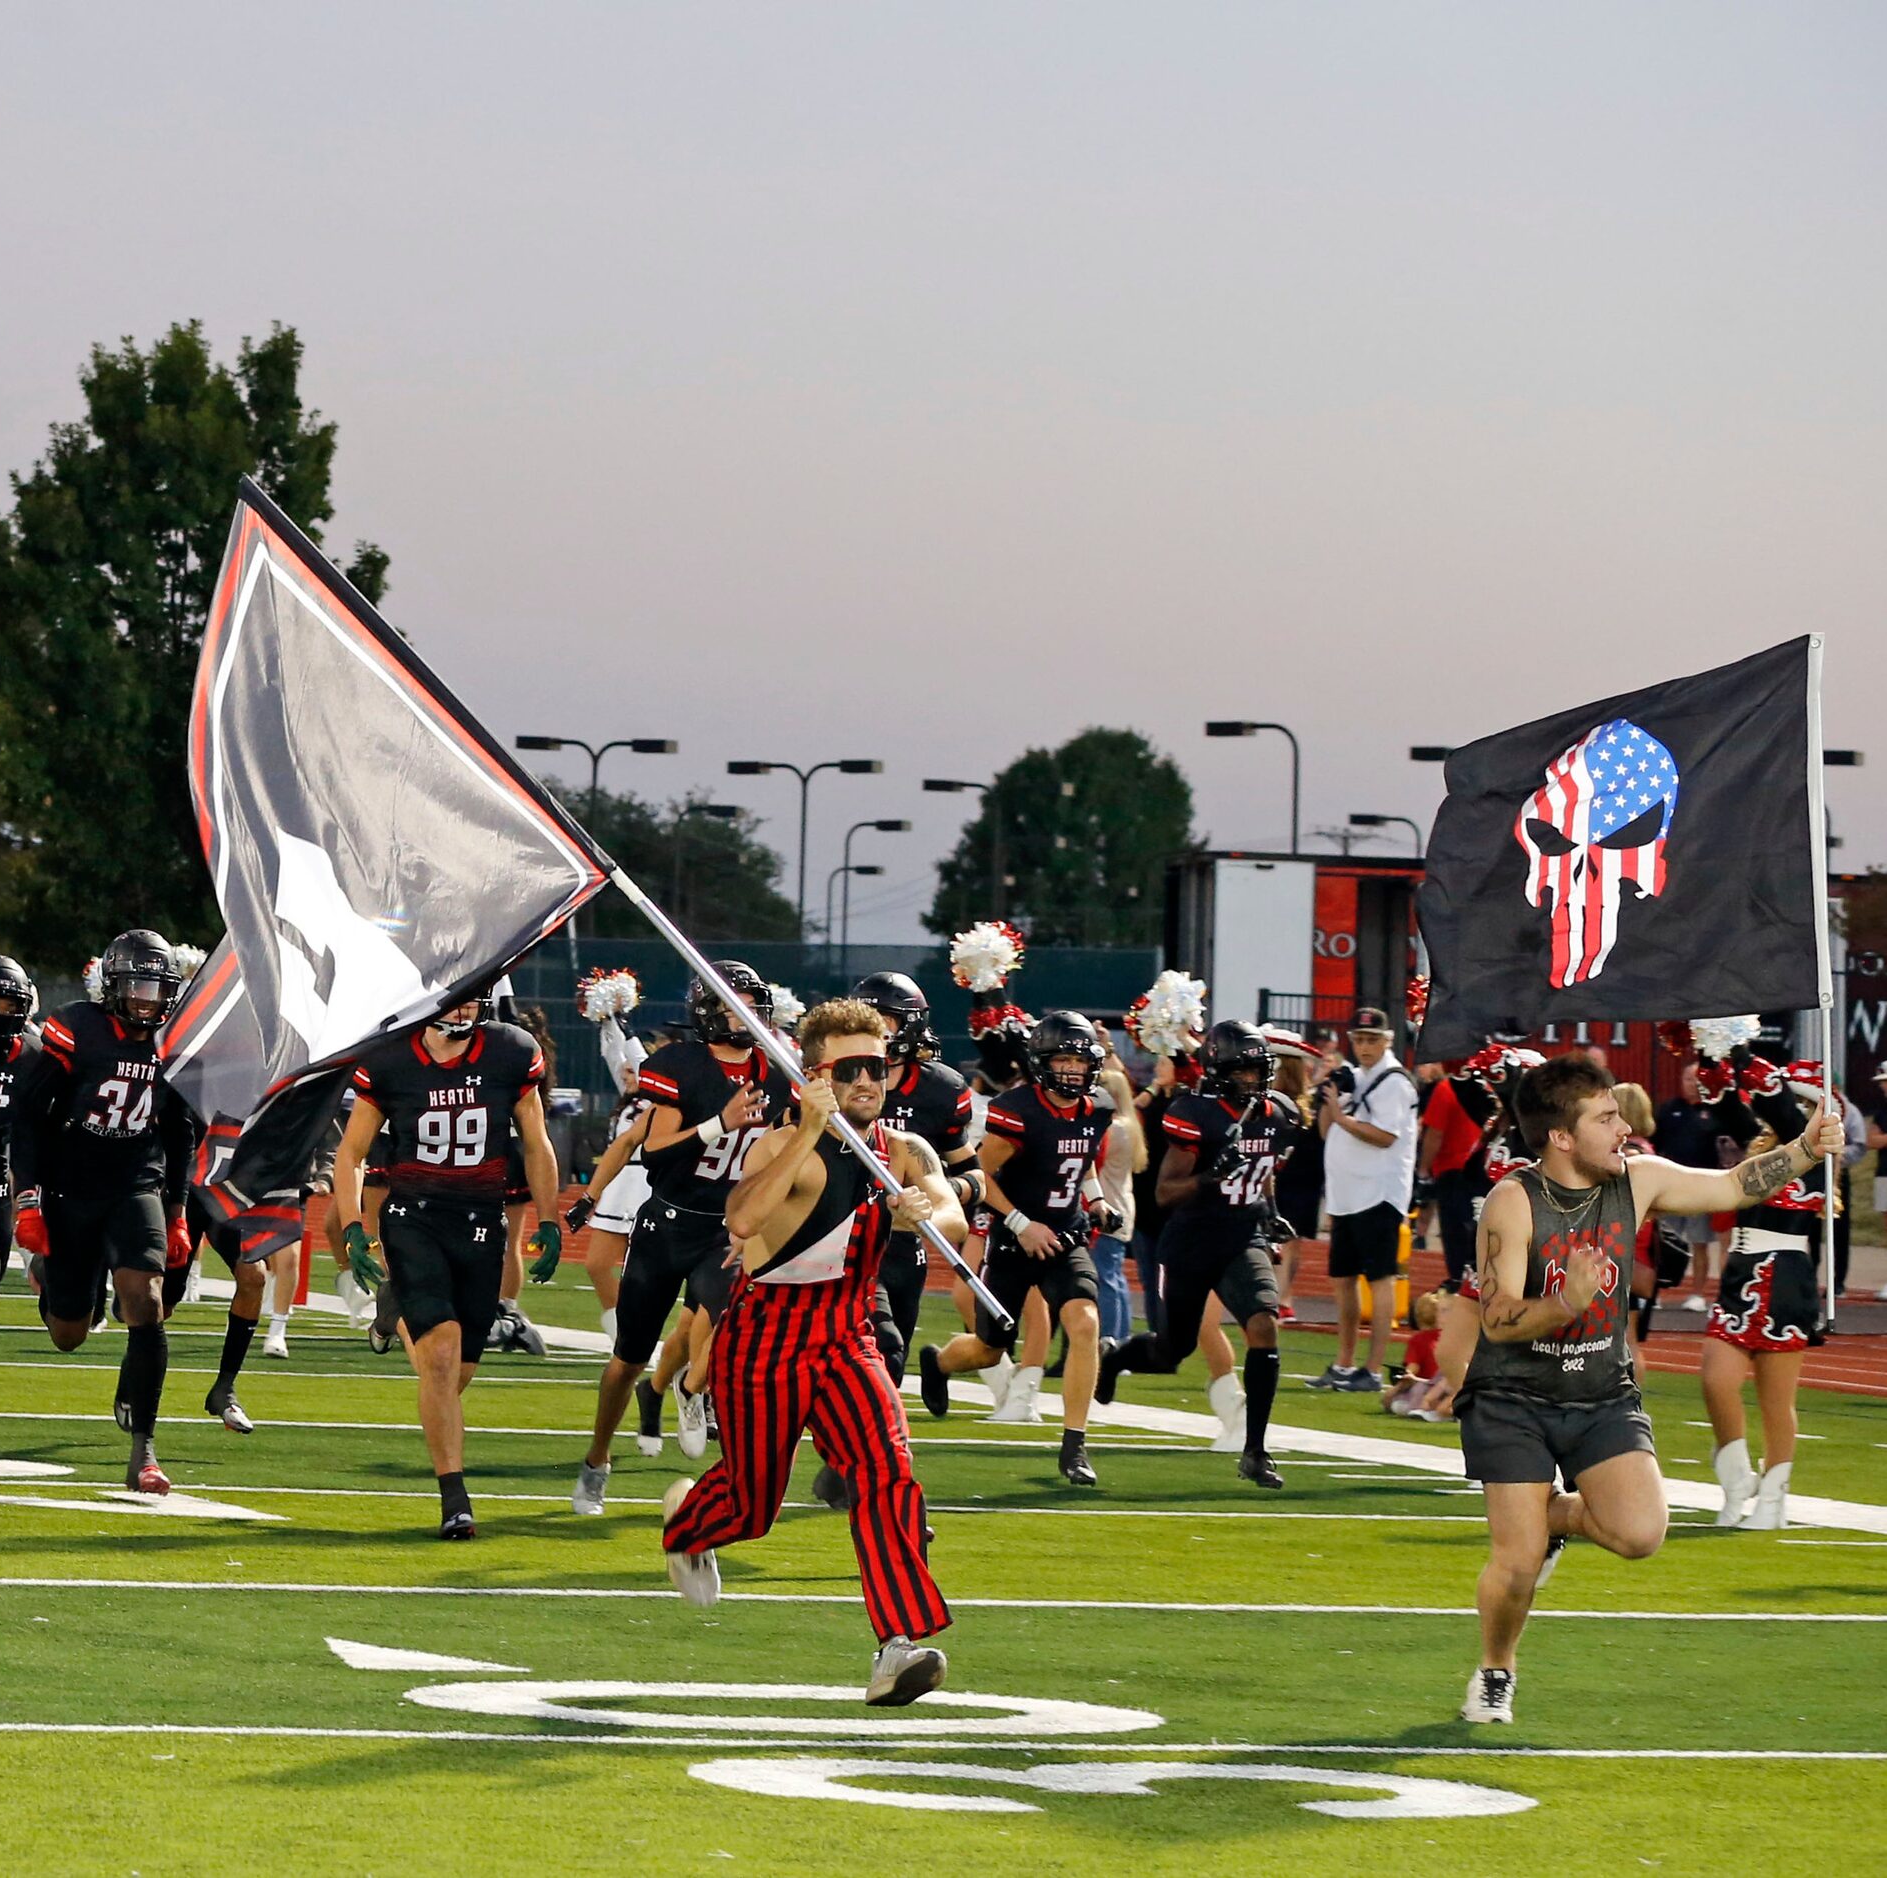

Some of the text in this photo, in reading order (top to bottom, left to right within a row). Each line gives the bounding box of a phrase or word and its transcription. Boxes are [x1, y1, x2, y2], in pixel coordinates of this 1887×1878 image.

[116, 1061, 156, 1081] HEATH
[87, 1079, 153, 1131] 34
[428, 1087, 476, 1107] HEATH
[416, 1106, 488, 1167] 99
[1057, 1139, 1090, 1154] HEATH
[1237, 1138, 1271, 1153] HEATH
[1046, 1157, 1084, 1208] 3
[473, 1227, 488, 1242] H
[1561, 1356, 1585, 1372] 2022
